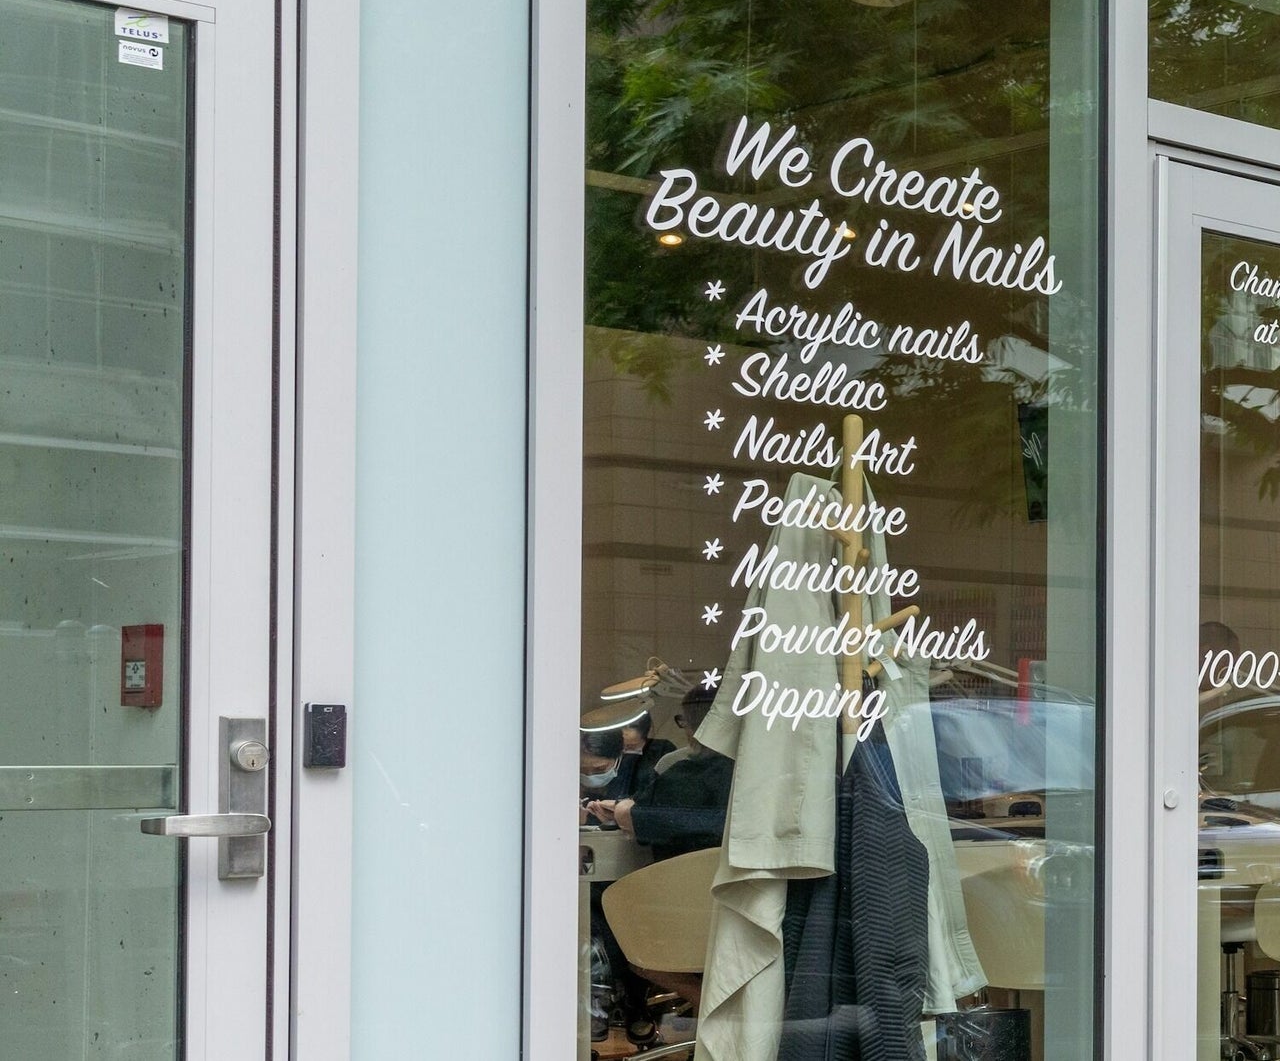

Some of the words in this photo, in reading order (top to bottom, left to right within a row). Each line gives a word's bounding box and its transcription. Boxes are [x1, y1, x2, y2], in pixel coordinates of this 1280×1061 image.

[121, 26, 160, 39] TELUS
[726, 114, 813, 188] We
[830, 138, 1003, 224] Create
[645, 168, 853, 289] Beauty
[865, 219, 921, 271] in
[932, 221, 1063, 296] Nails
[735, 288, 881, 363] Acrylic
[889, 319, 983, 365] nails
[1254, 319, 1278, 344] at
[731, 352, 888, 411] Shellac
[733, 414, 841, 468] Nails
[851, 428, 916, 476] Art
[731, 479, 908, 536] Pedicure
[730, 544, 921, 597] Manicure
[730, 606, 884, 657] Powder
[893, 616, 990, 662] Nails
[731, 670, 889, 743] Dipping
